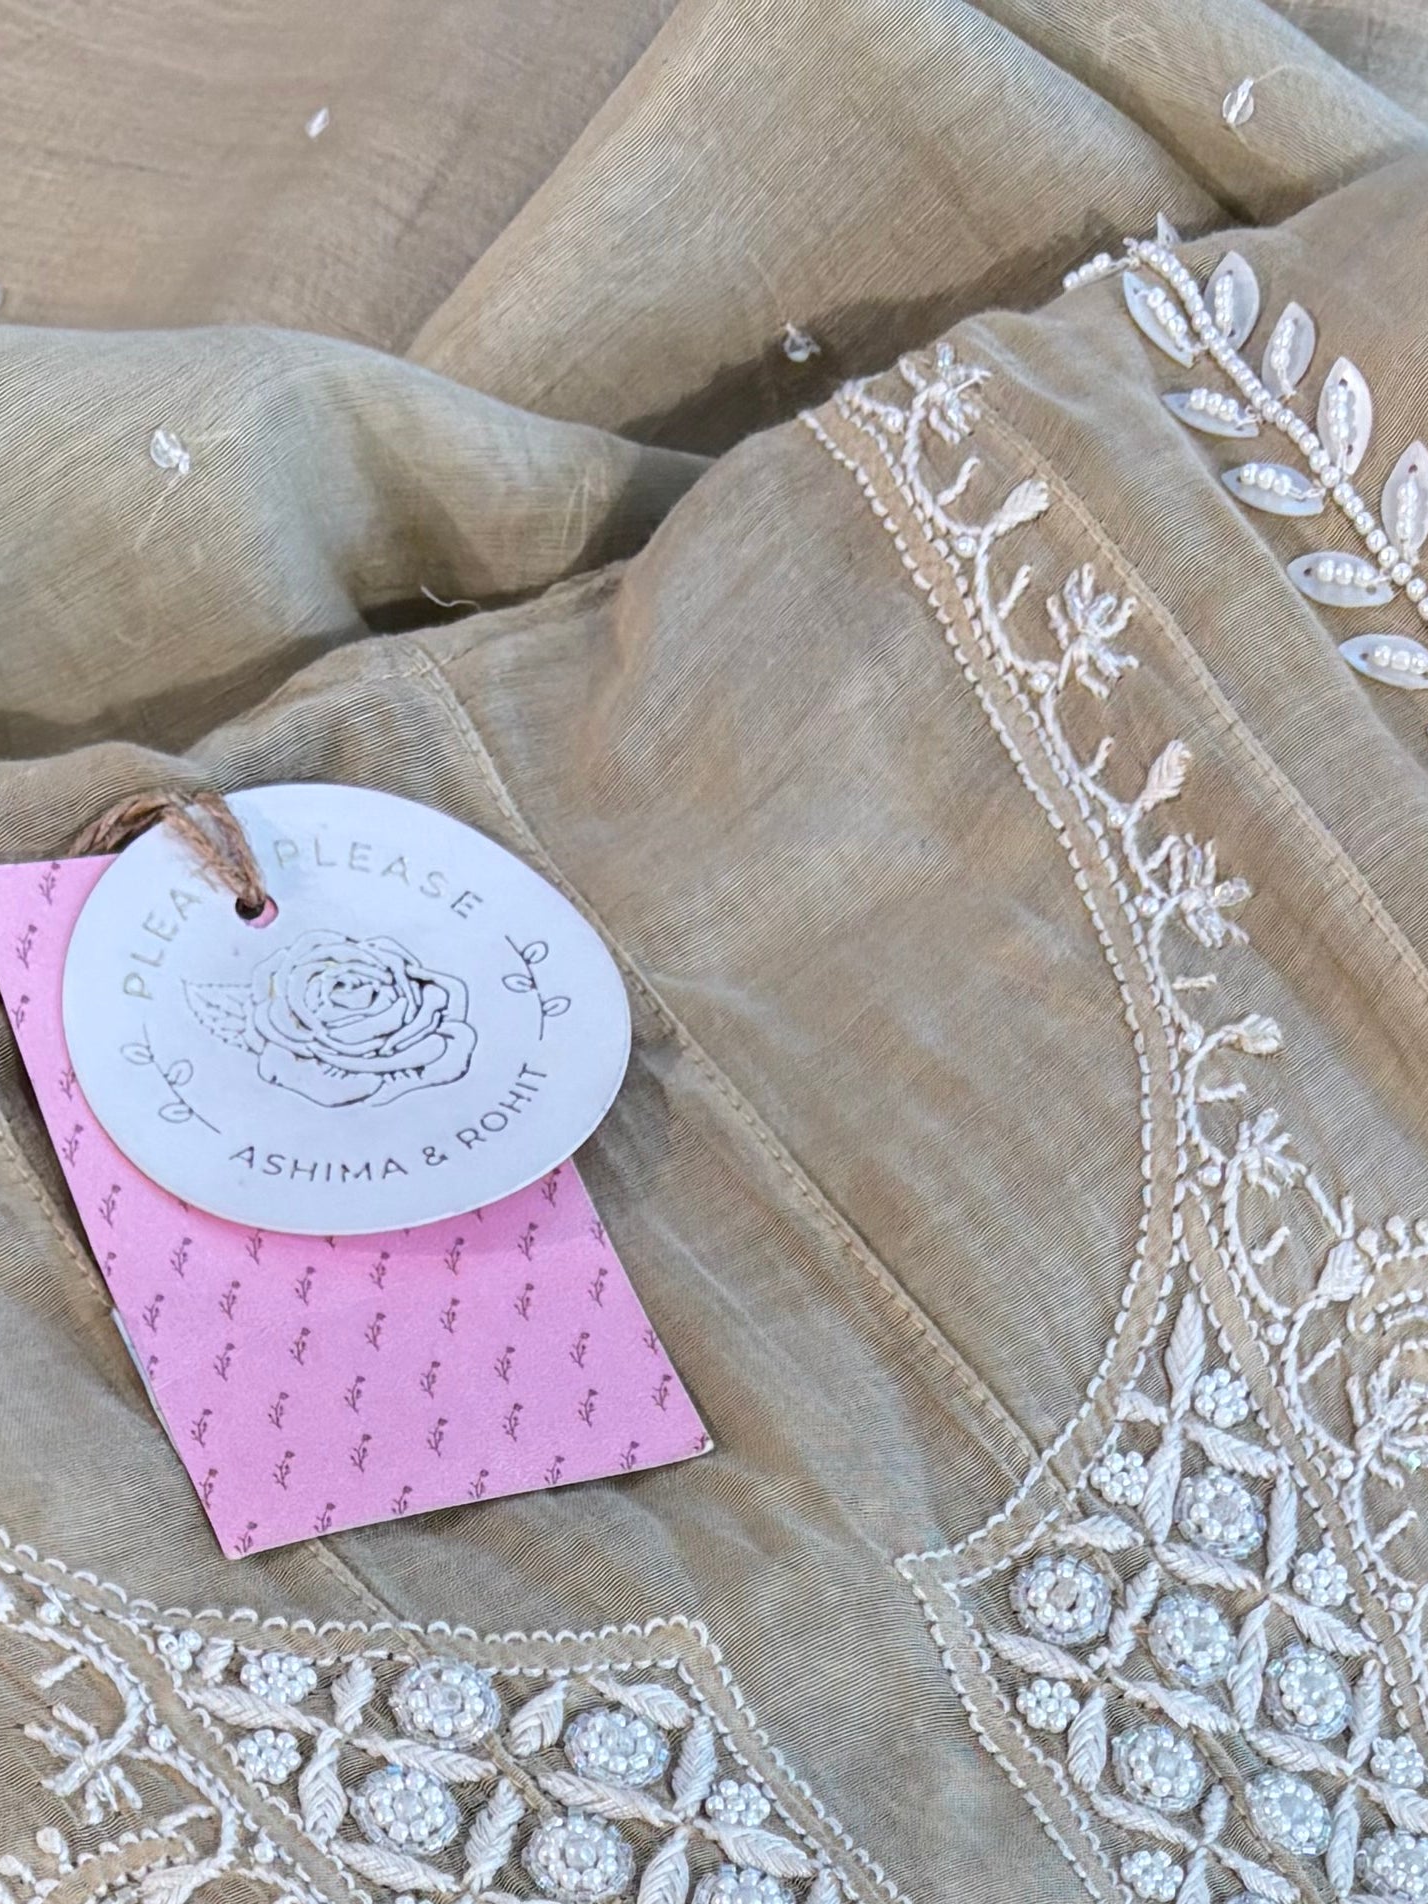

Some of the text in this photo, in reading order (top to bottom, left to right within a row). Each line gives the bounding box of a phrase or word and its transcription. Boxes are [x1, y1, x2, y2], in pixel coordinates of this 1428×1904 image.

[272, 834, 484, 919] PLEASE
[229, 1062, 548, 1183] ASHIMA & ROHIT
